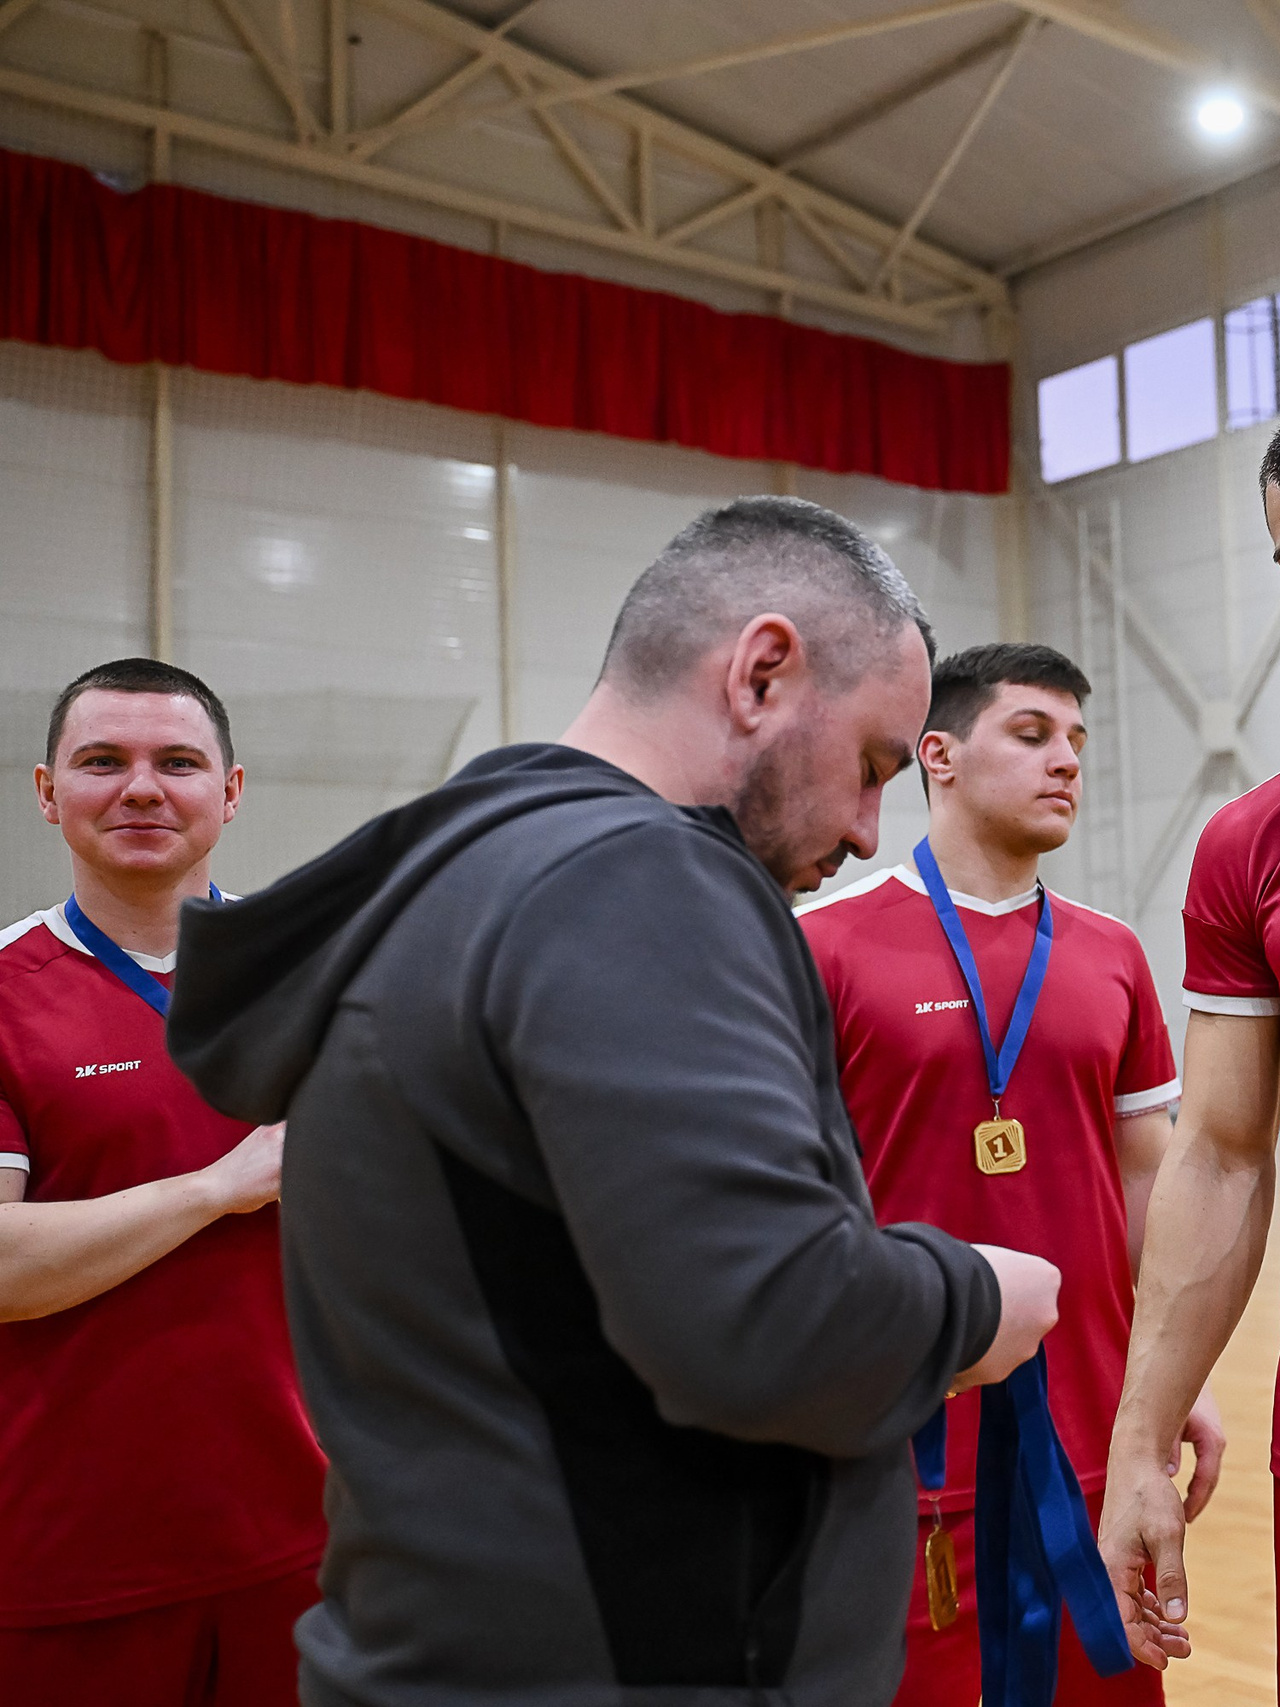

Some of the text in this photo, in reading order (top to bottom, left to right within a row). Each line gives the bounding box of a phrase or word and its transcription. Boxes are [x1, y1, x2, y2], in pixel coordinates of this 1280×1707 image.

[915, 999, 969, 1014] 2K SPORT
[75, 1060, 142, 1079] 2K SPORT
[992, 1137, 1008, 1159] 1
